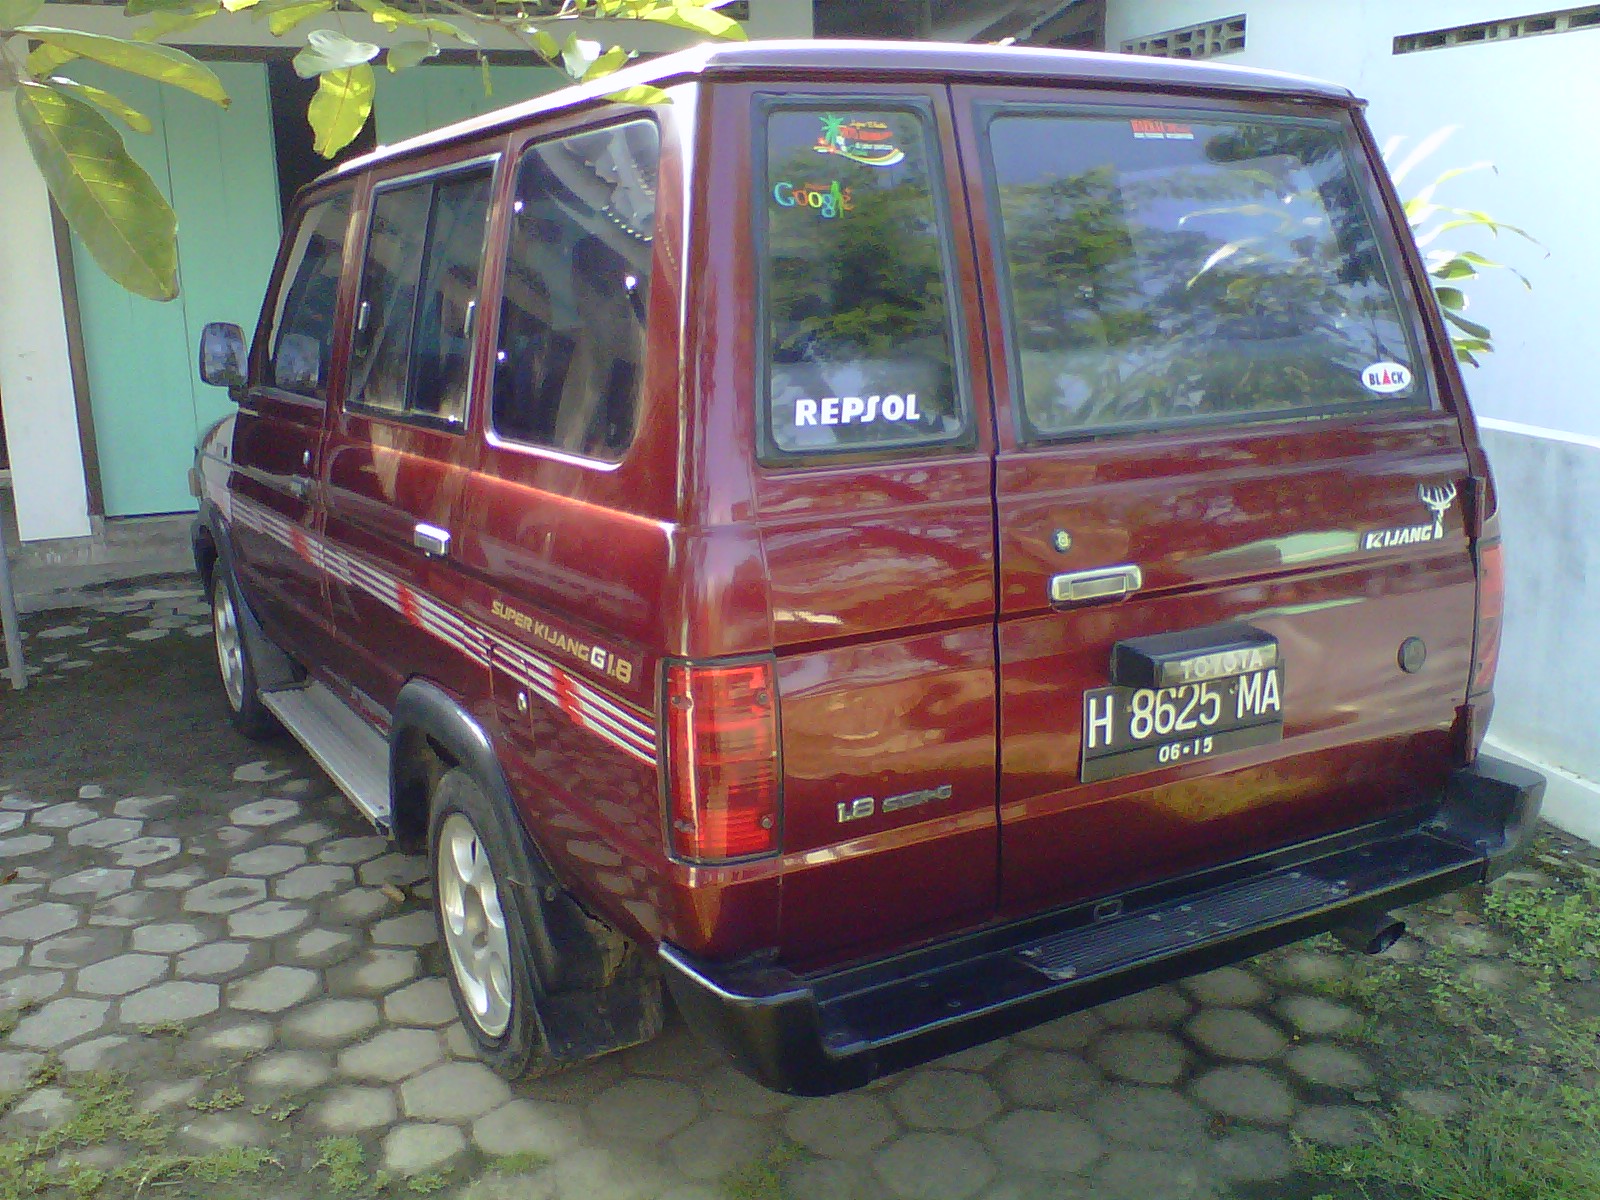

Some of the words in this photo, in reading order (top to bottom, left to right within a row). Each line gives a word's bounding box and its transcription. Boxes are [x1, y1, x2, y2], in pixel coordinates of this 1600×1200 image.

[774, 180, 854, 219] Google
[1368, 368, 1405, 386] BLACK
[794, 393, 921, 427] REPSOL
[1365, 524, 1434, 550] KIJANG
[491, 599, 533, 633] SUPER
[534, 621, 590, 662] KIJANG
[1180, 650, 1264, 680] TOYOTA
[1088, 695, 1114, 749] H
[1130, 683, 1222, 740] 8625
[1236, 669, 1282, 719] MA
[837, 796, 875, 823] 1.8
